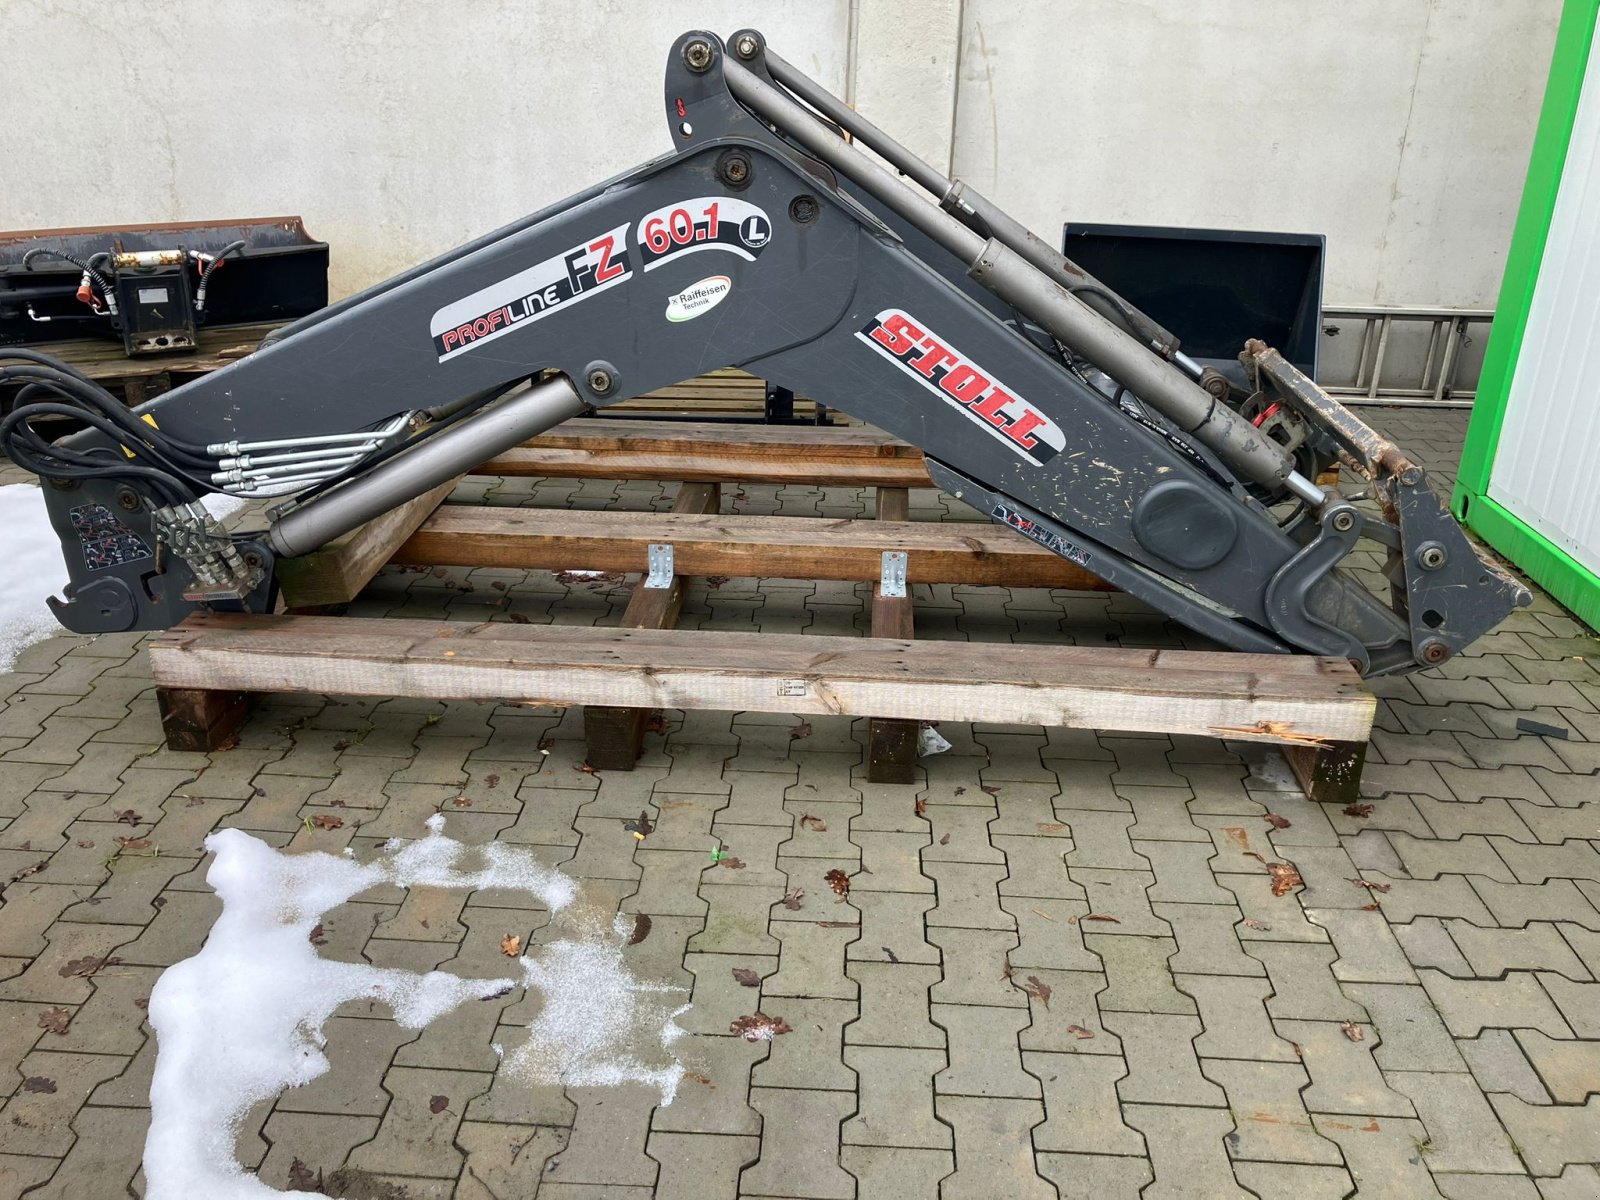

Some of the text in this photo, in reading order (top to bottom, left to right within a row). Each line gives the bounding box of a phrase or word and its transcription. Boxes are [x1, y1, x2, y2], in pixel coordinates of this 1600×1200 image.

[645, 202, 766, 255] 60.1 L
[563, 235, 626, 296] FZ
[679, 284, 727, 303] Raiffeisen
[682, 298, 710, 311] Technik
[868, 313, 1047, 451] STOLL
